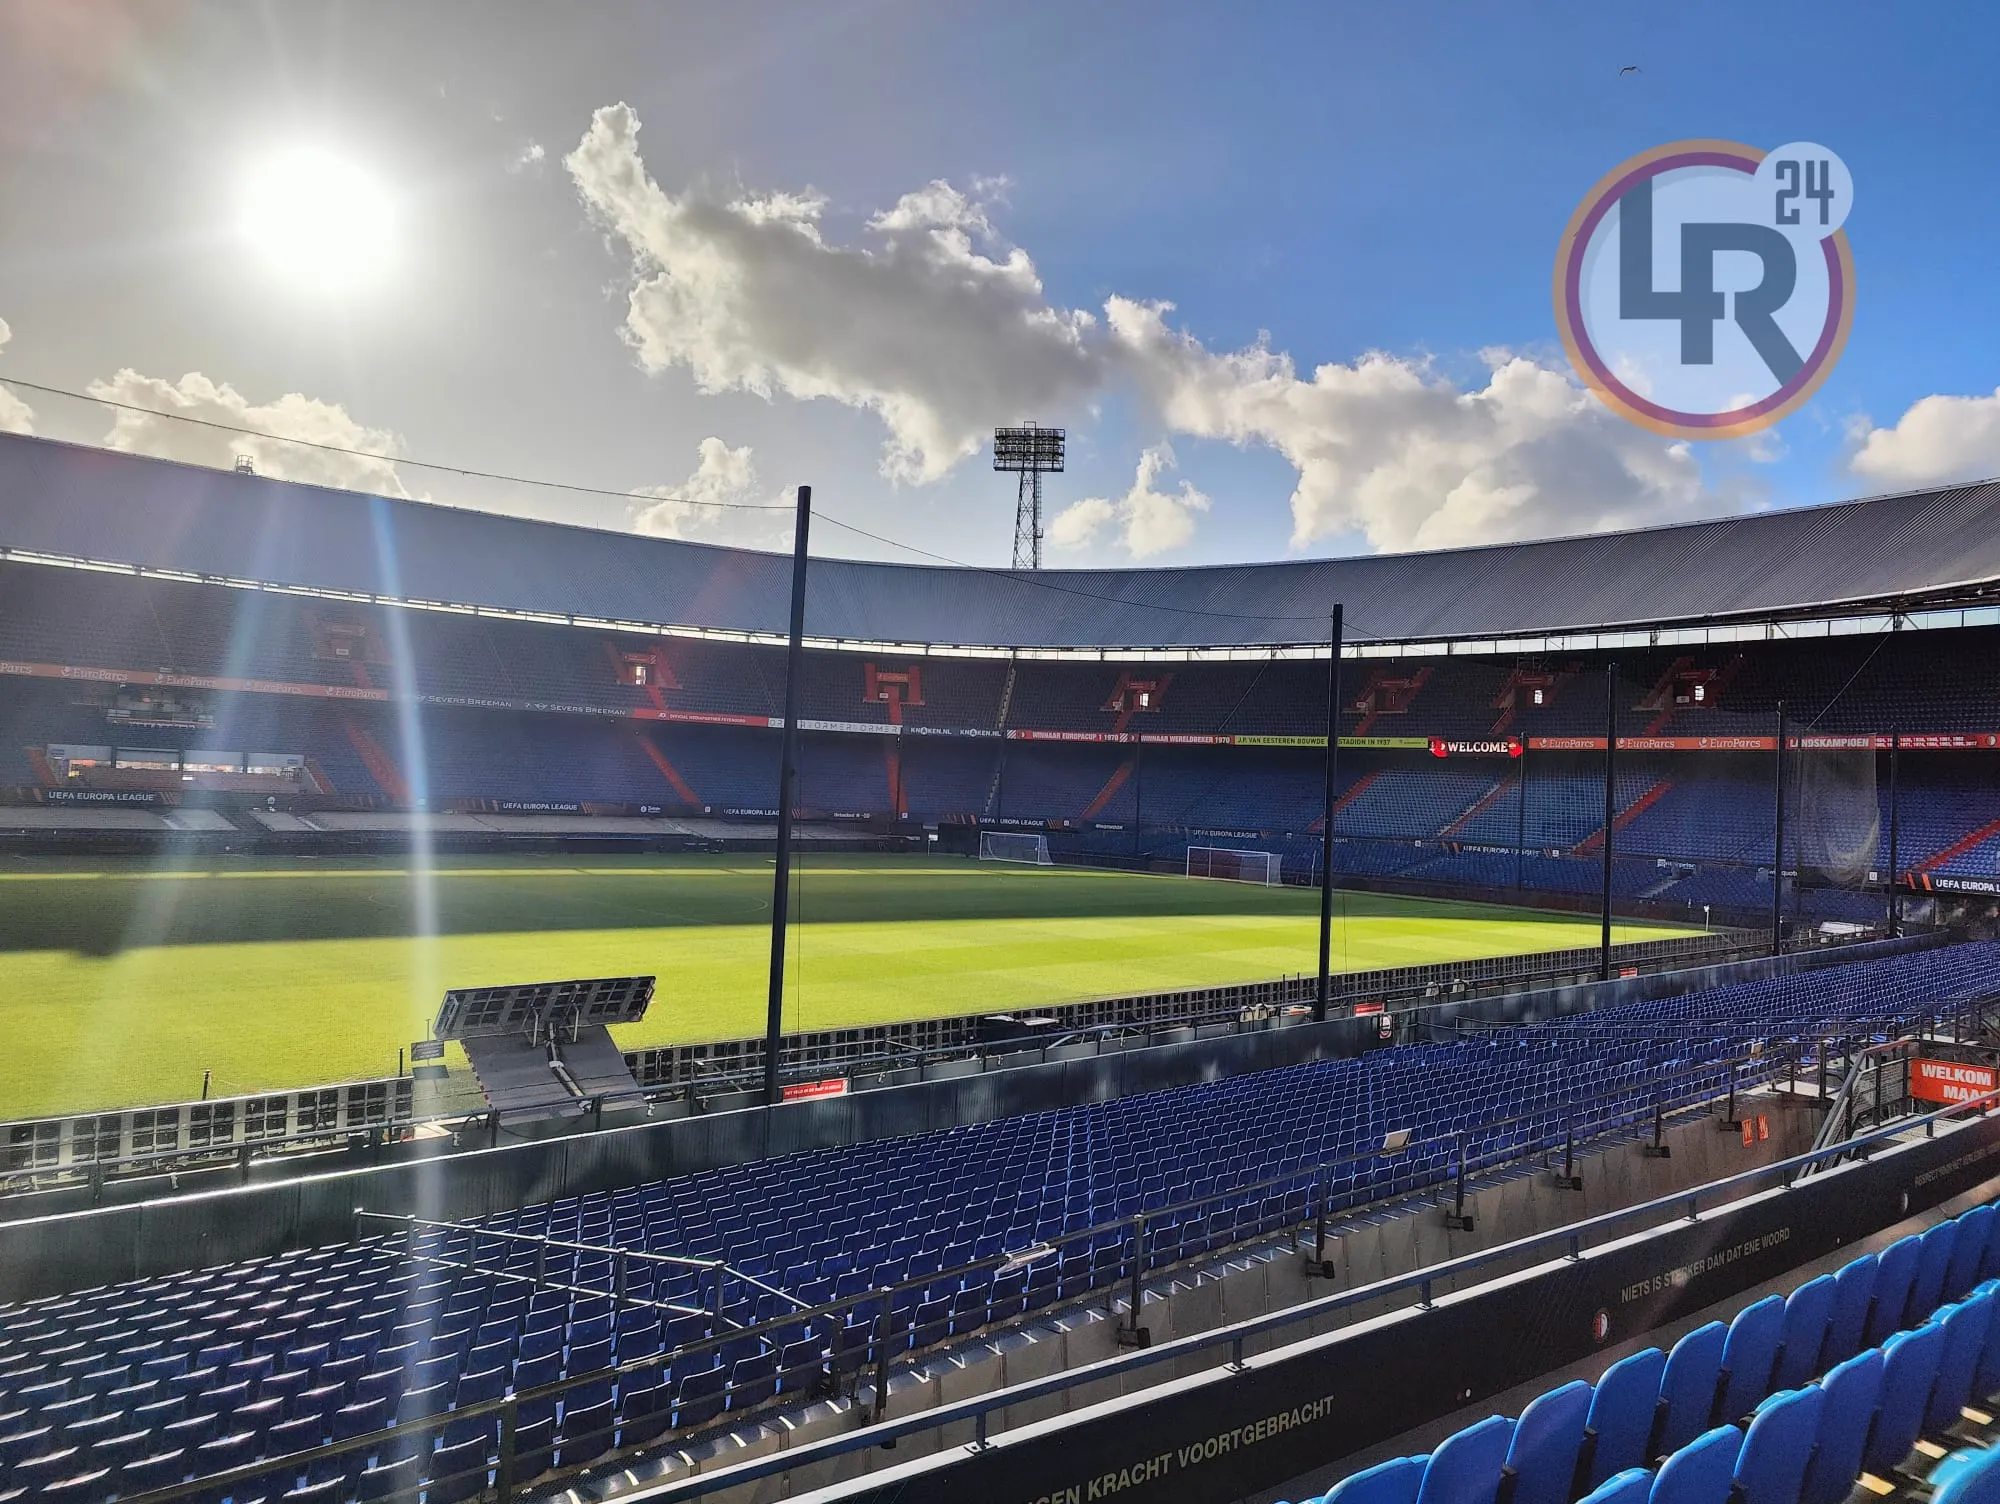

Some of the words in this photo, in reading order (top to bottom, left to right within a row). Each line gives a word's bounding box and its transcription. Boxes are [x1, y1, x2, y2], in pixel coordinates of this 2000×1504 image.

[73, 667, 129, 682] EuroParcs
[1032, 731, 1061, 739] WINNAAR
[1062, 732, 1097, 740] EUROPACUP
[1140, 735, 1169, 743] WINNAAR
[1170, 735, 1213, 744] WERELDBEKER
[1215, 736, 1230, 744] 1970
[1448, 741, 1508, 753] WELCOME
[1550, 738, 1594, 749] EuroParcs
[1627, 738, 1675, 749] EuroParcs
[1710, 738, 1761, 748] EuroParcs
[48, 791, 74, 800] UEFA
[77, 792, 115, 801] EUROPA
[117, 793, 155, 801] LEAGUE
[551, 803, 578, 811] LEAGUE
[1020, 819, 1044, 827] LEAGUE
[1233, 831, 1257, 839] LEAGUE
[1482, 846, 1510, 855] EUROPA
[1936, 879, 1959, 889] UEFA
[1962, 881, 1995, 892] EUROPA
[1921, 1063, 1992, 1086] WELKOM
[1621, 1279, 1650, 1303] NIETS
[1652, 1274, 1662, 1293] IS
[1663, 1259, 1705, 1288] STERKER
[1707, 1251, 1725, 1271] DAN
[1727, 1244, 1743, 1263] DAT
[1744, 1238, 1760, 1257] ENE
[1762, 1227, 1790, 1249] WOORD
[1088, 1453, 1173, 1501] KRACHT
[1178, 1394, 1335, 1469] VOORTGEBRACHT
